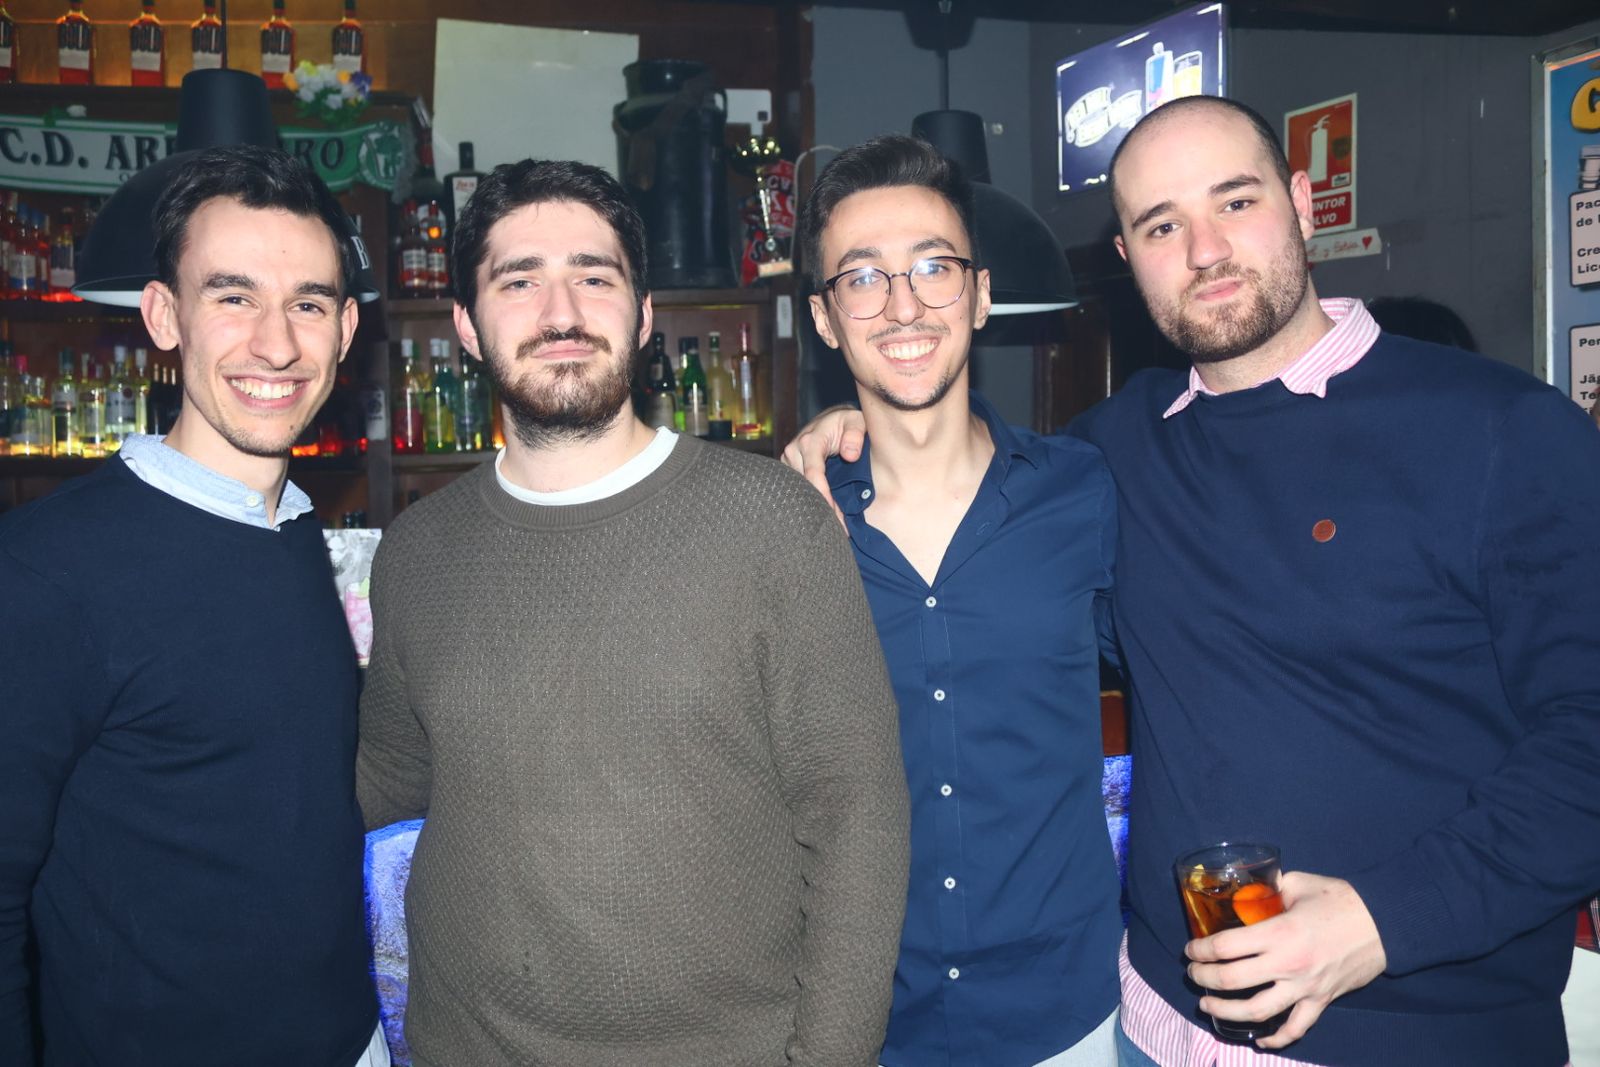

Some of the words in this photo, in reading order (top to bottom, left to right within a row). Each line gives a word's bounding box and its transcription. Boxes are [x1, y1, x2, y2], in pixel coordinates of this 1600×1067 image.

[0, 127, 89, 169] C.D.
[1576, 217, 1593, 228] de
[1577, 263, 1600, 274] Lic
